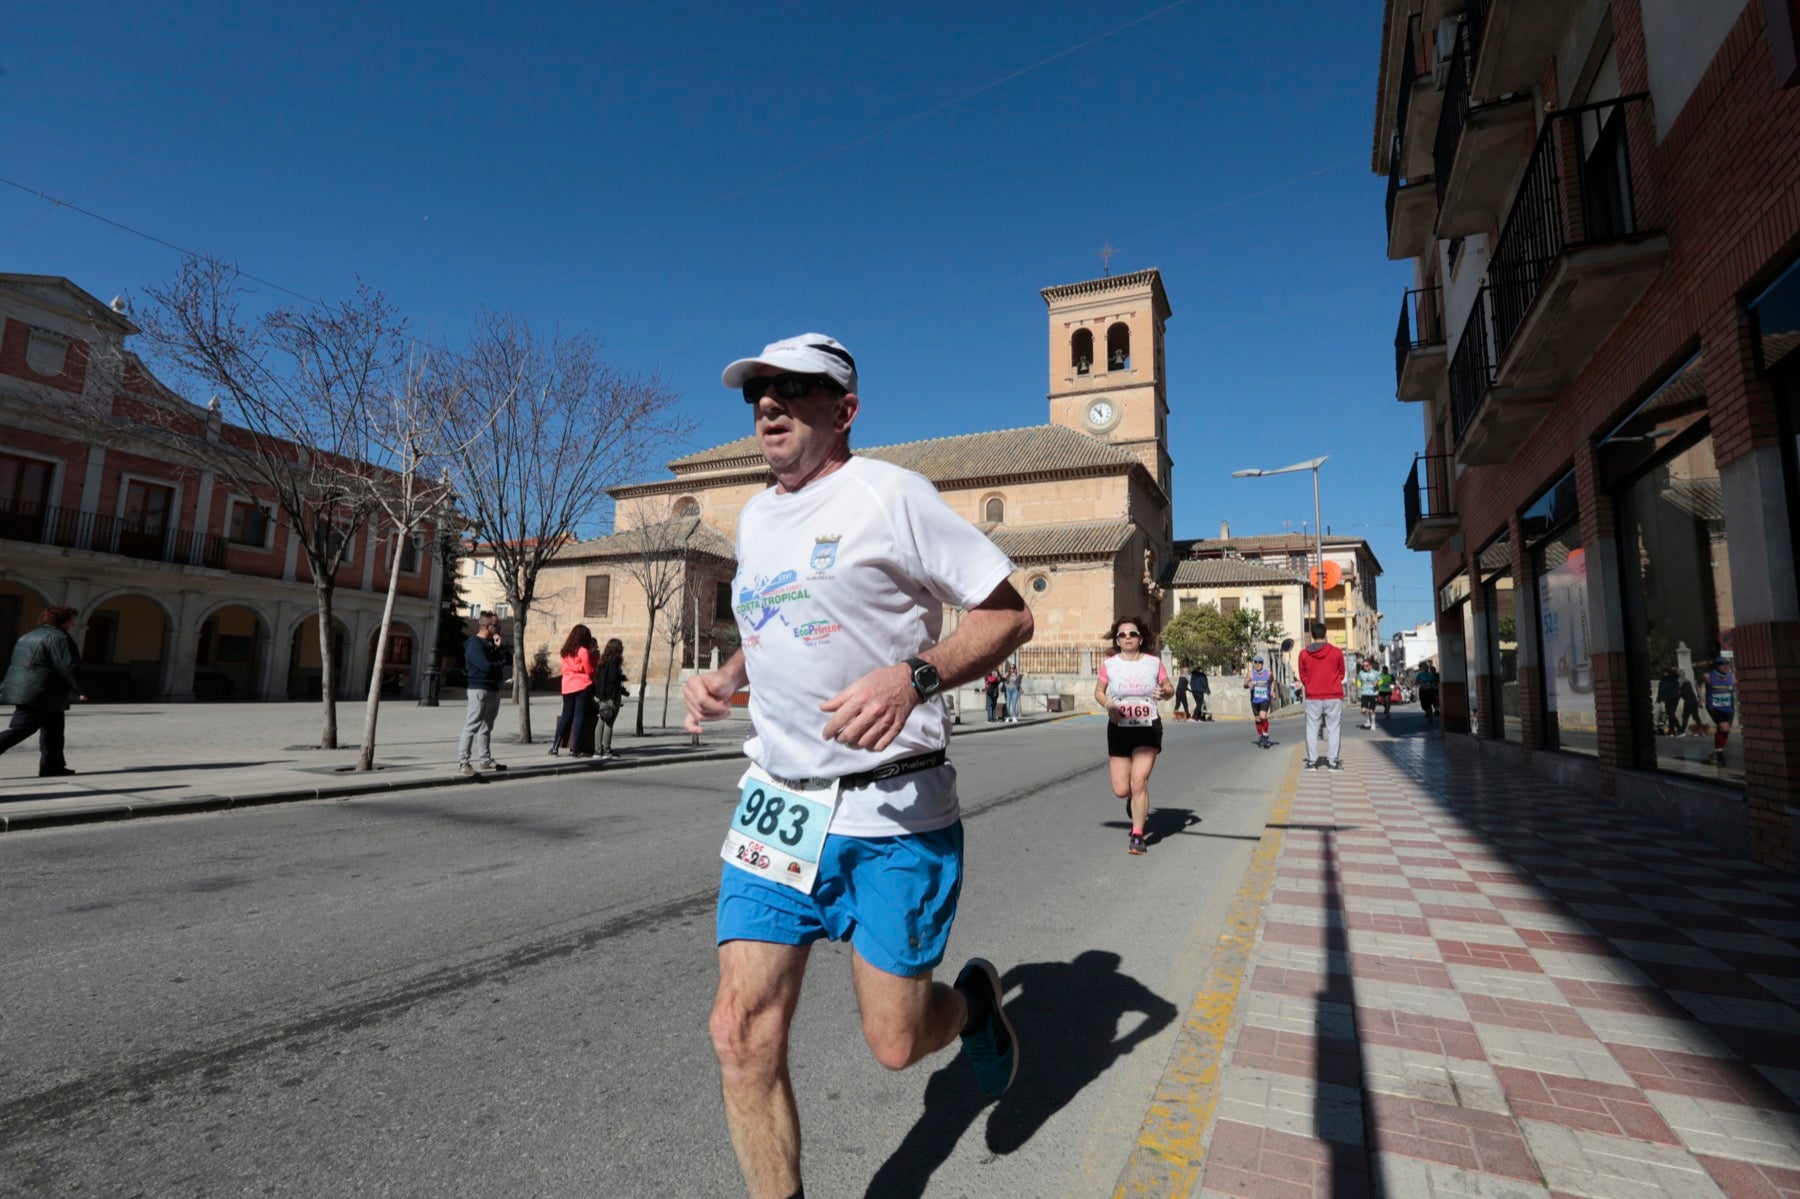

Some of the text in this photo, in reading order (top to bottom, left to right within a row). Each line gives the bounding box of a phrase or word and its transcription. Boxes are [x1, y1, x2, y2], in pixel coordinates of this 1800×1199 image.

[736, 600, 760, 615] COSTA
[761, 588, 811, 608] TROPICAL
[793, 623, 842, 638] EcoPrinter
[1120, 706, 1150, 718] 2169
[740, 788, 810, 847] 983
